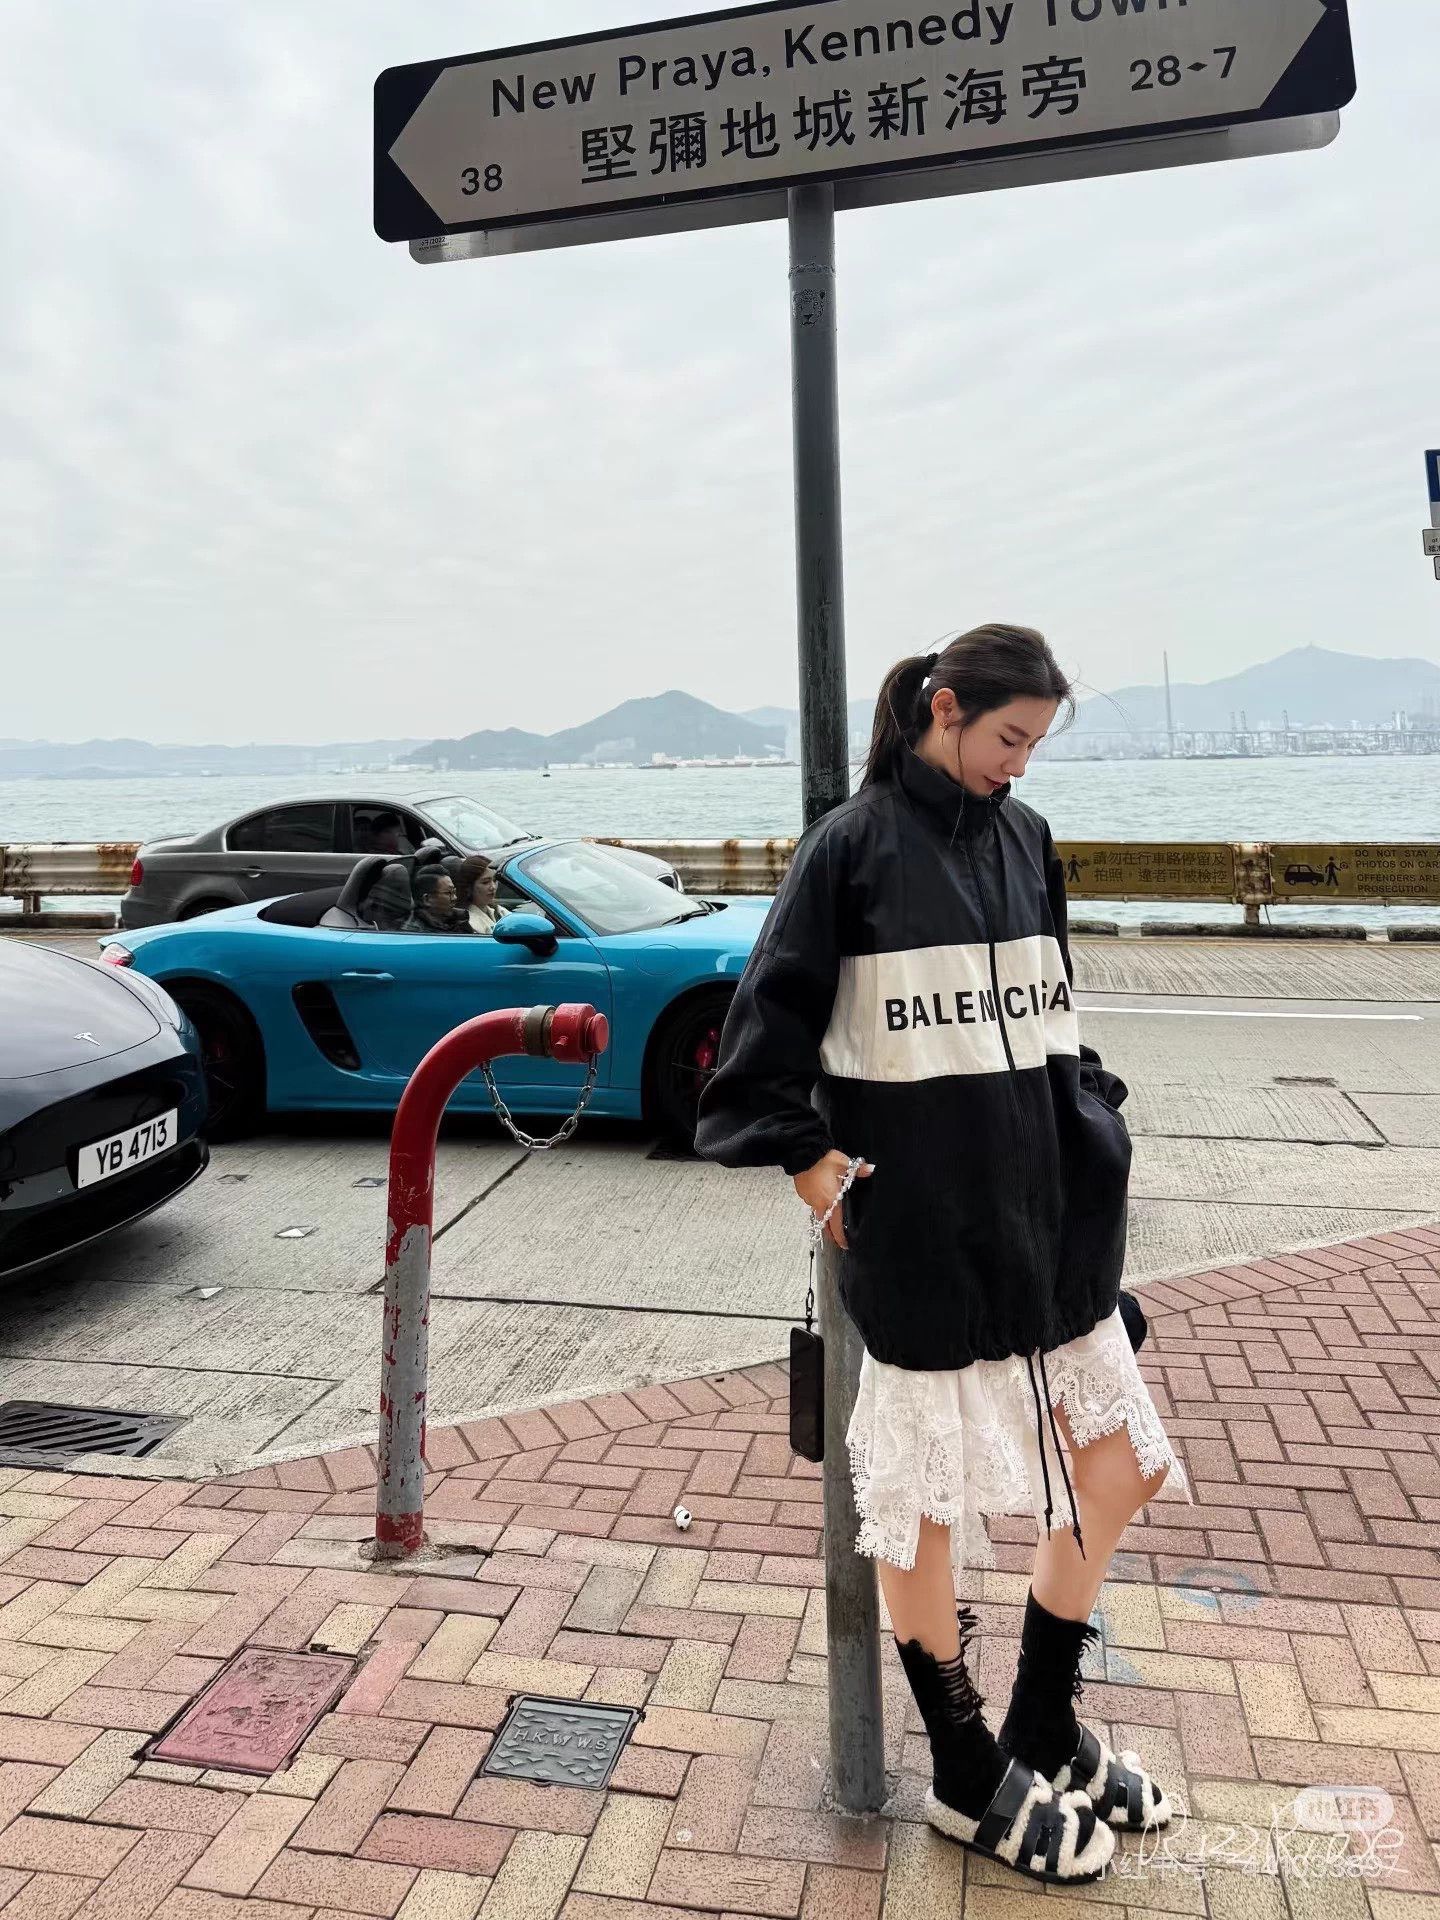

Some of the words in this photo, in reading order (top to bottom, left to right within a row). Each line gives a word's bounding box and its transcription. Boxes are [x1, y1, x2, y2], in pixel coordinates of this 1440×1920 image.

[492, 72, 596, 118] New
[619, 43, 771, 96] Praya,
[785, 0, 1014, 68] Kennedy
[1129, 54, 1182, 91] 28
[580, 55, 1087, 184] 堅彌地城新海旁
[460, 163, 504, 196] 38
[1092, 851, 1227, 865] 請勿在行車路停留及
[1355, 849, 1368, 857] DO
[1377, 849, 1395, 857] NOT
[1404, 849, 1428, 857] STAY
[1356, 860, 1396, 868] PHOTOS
[1400, 860, 1414, 868] ON
[1357, 874, 1416, 882] OFFENDERS
[1420, 874, 1439, 882] ARE
[1358, 885, 1428, 893] PROSECUTION
[96, 1139, 123, 1175] YB
[128, 1118, 167, 1159] 4713
